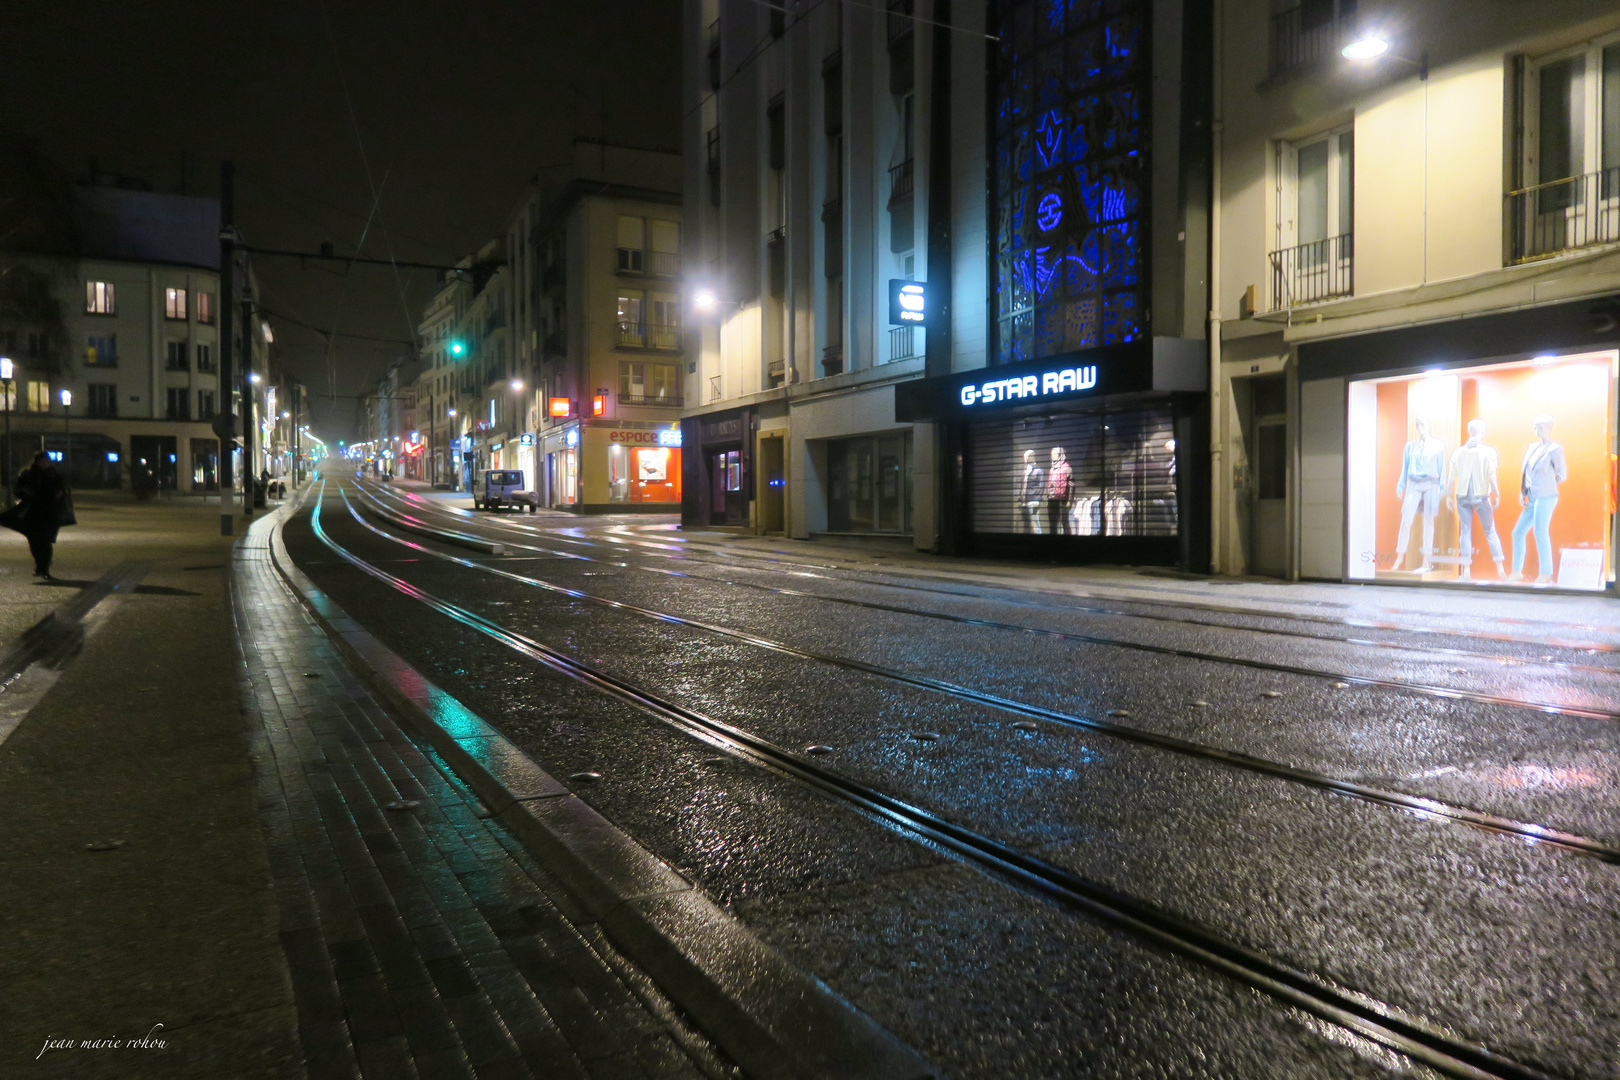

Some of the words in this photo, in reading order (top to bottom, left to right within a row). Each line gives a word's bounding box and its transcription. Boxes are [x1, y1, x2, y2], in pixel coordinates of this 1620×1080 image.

[961, 374, 1037, 406] G-STAR
[1043, 365, 1096, 395] RAW
[610, 431, 658, 443] espace
